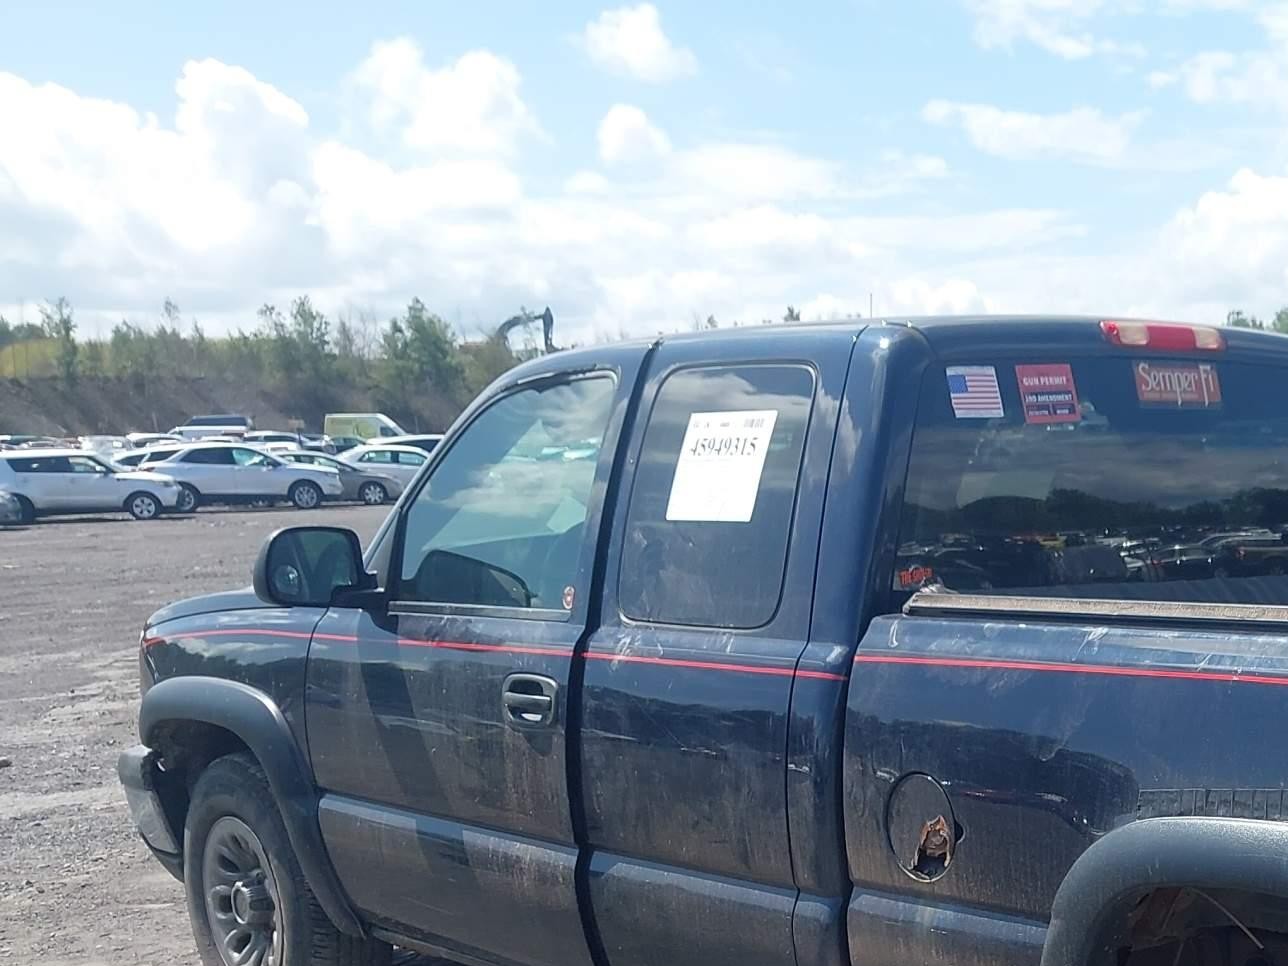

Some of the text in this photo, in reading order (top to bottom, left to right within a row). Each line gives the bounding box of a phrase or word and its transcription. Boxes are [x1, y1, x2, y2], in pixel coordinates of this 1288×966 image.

[1023, 376, 1067, 386] GUN PERMIT
[1139, 363, 1198, 406] Semper
[690, 437, 759, 456] 45949315
